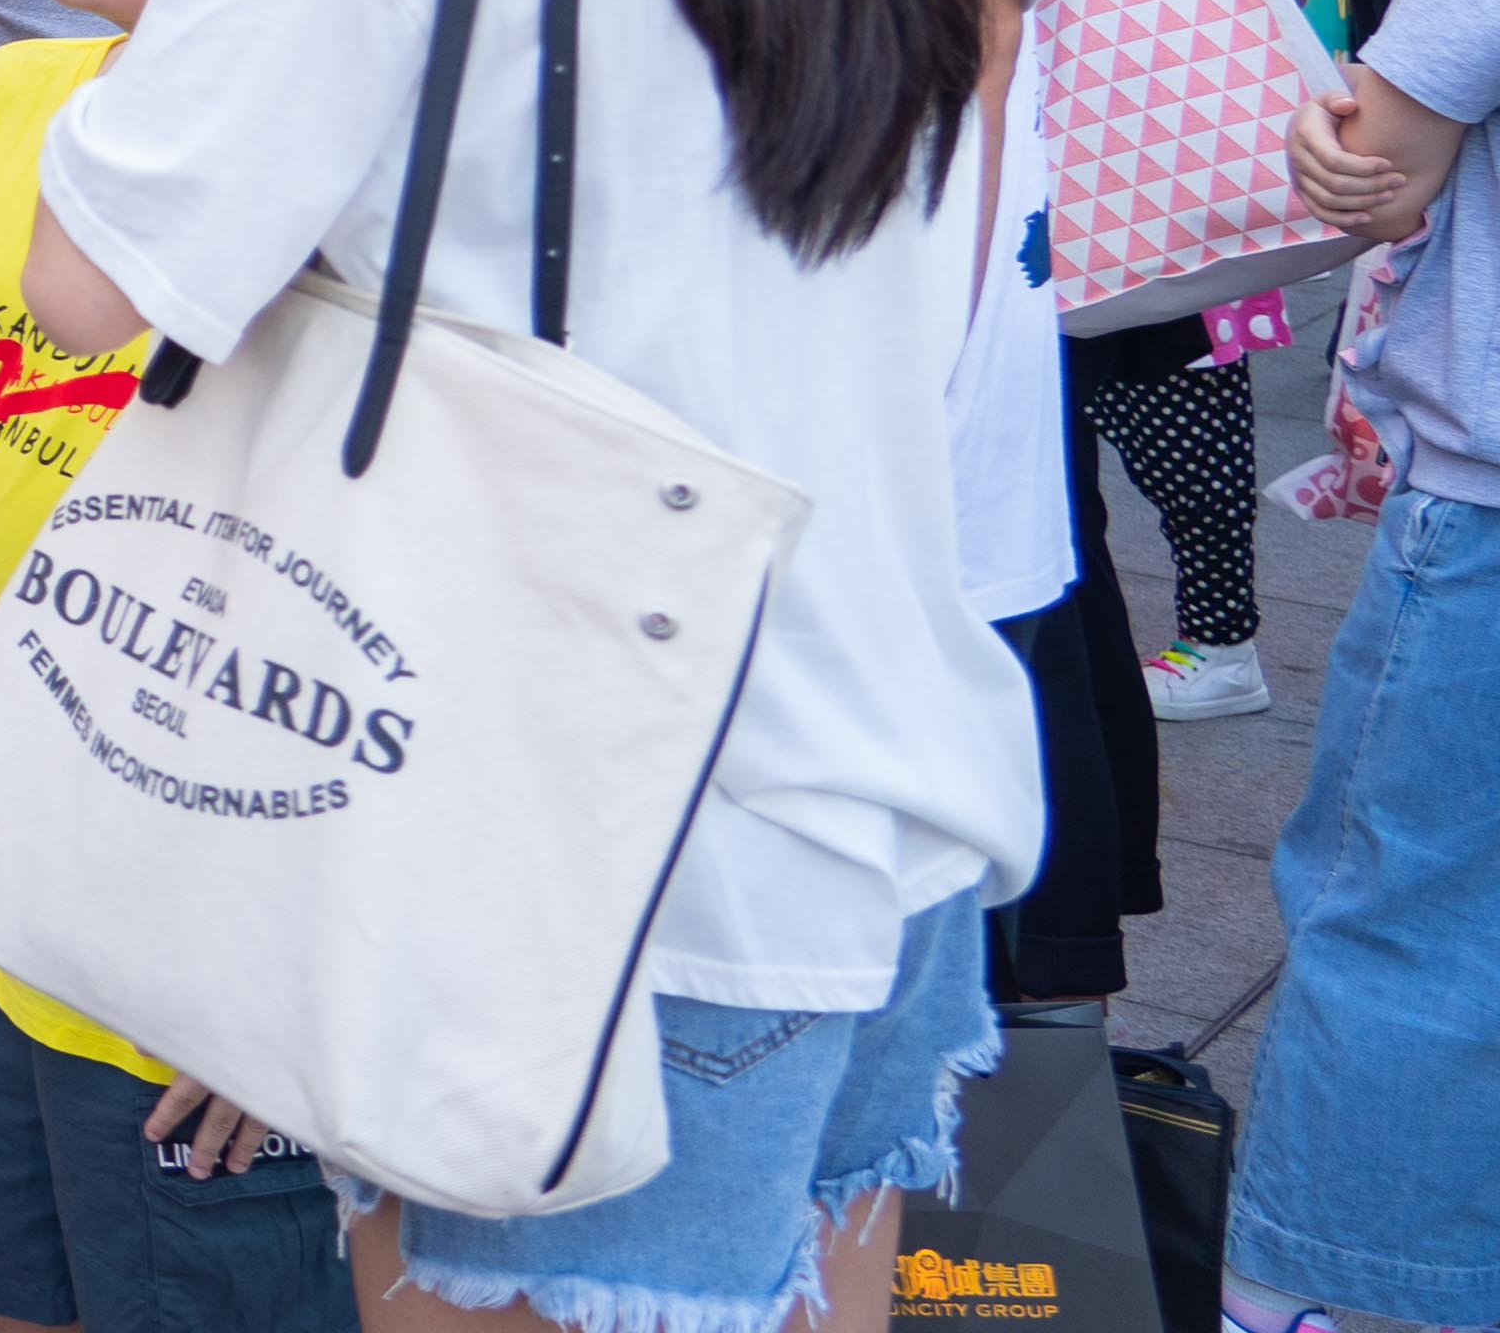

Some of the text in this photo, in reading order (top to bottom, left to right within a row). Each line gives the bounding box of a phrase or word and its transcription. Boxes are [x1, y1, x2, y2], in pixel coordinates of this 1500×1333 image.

[14, 548, 416, 775] BOULEVARDS
[51, 494, 197, 532] ESSENTIAL
[275, 550, 419, 684] JOURNEY
[17, 628, 351, 820] FEMMES INCONTOURNABLES
[131, 687, 188, 740] SEOUL
[889, 1302, 1061, 1319] UNCITY GROUP
